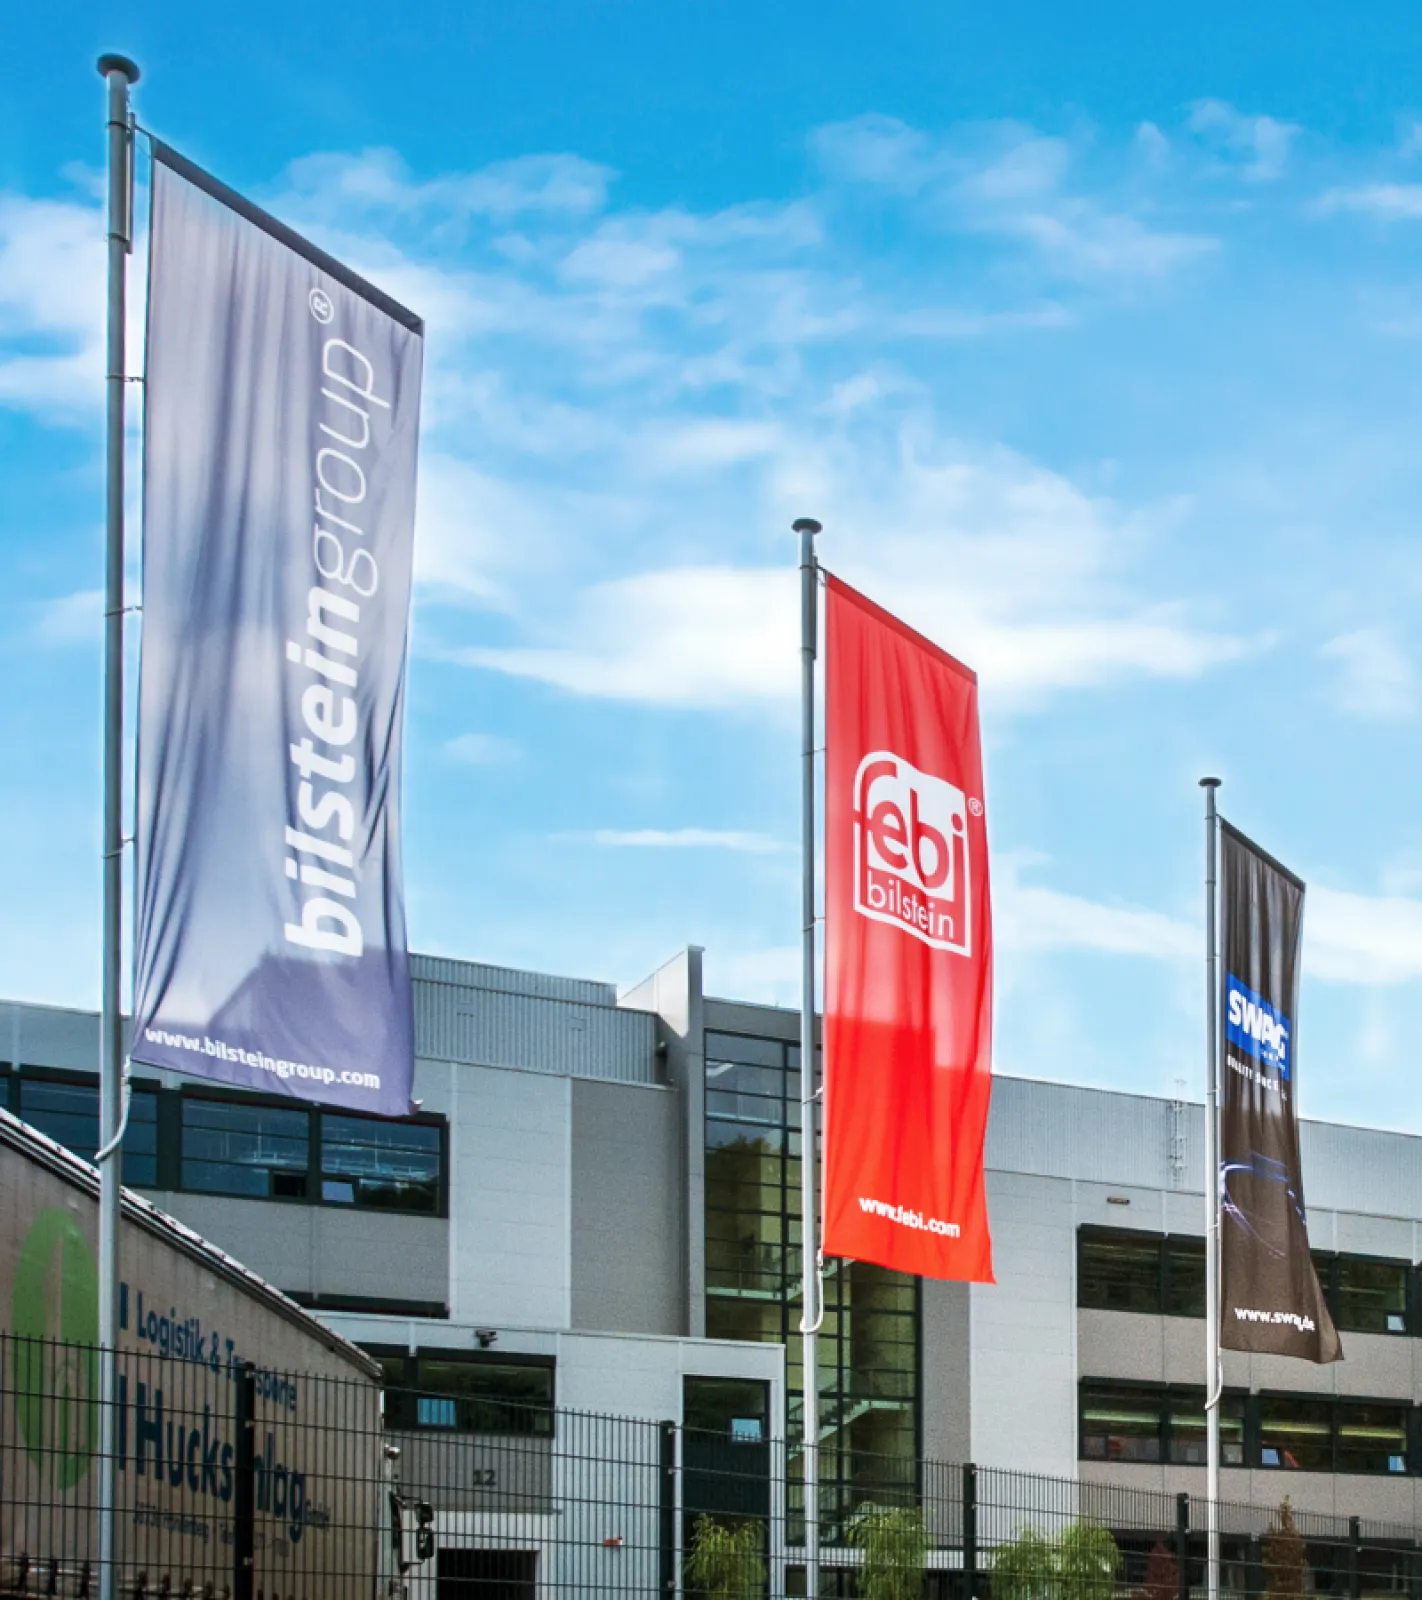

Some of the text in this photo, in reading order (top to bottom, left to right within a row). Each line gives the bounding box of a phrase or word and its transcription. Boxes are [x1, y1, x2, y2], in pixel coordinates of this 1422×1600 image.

[285, 338, 390, 957] bilsteingroup
[854, 755, 967, 900] febi
[867, 869, 954, 939] bilstein
[145, 1027, 381, 1090] www.bilsteingroup.com
[137, 1291, 204, 1363] Logistik
[210, 1331, 220, 1374] &
[136, 1381, 306, 1543] Huckslag
[473, 1469, 497, 1487] 12
